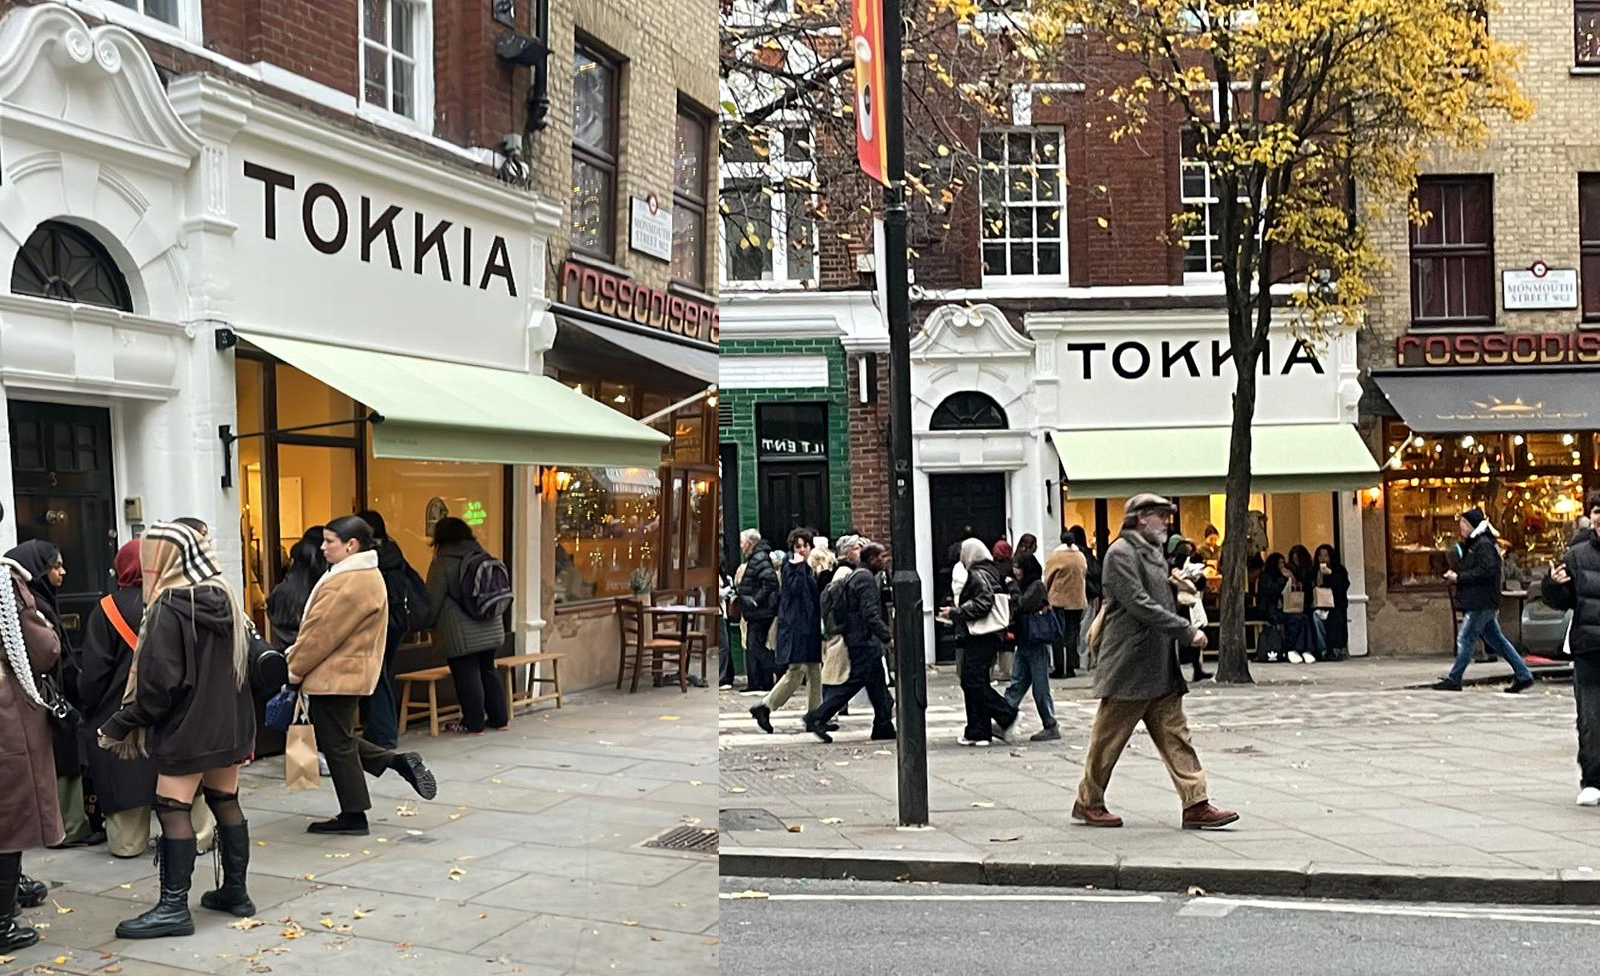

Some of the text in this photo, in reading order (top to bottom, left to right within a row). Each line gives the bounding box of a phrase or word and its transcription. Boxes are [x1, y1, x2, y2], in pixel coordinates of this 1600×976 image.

[244, 160, 517, 297] TOKKIA
[1507, 283, 1573, 294] MONMOUTH
[1511, 294, 1548, 303] STREET
[1067, 341, 1324, 379] TOKKIA
